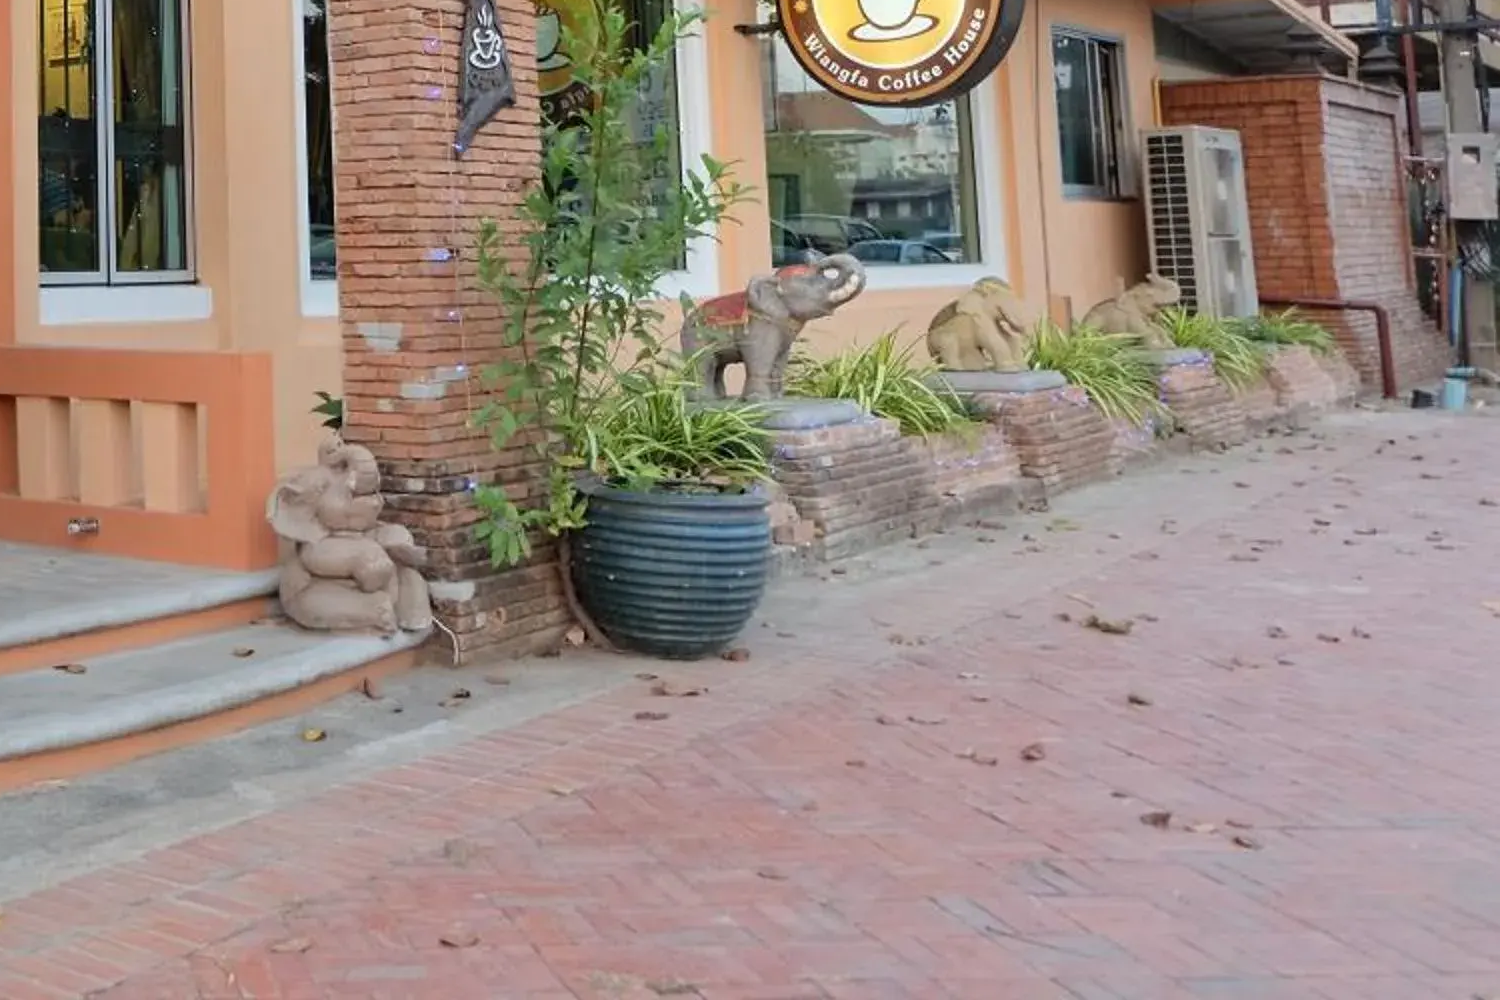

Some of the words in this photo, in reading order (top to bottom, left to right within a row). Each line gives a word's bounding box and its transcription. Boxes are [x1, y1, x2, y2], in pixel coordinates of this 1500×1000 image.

[804, 33, 869, 88] Wiangfa
[878, 67, 943, 91] Coffee
[944, 7, 985, 65] House
